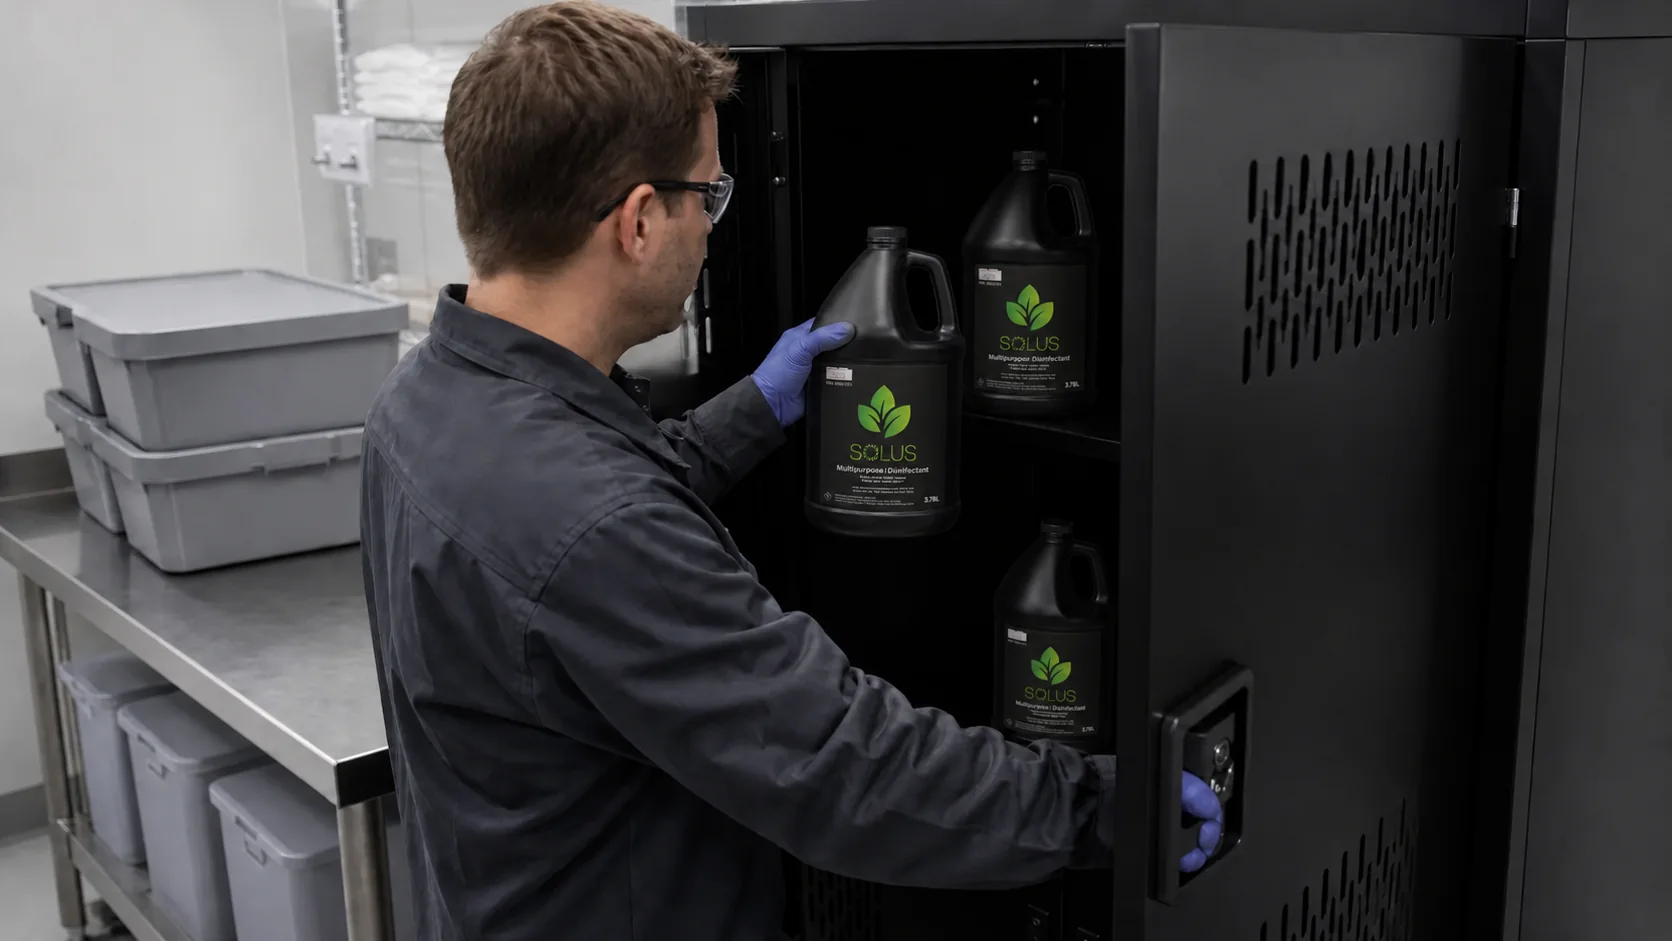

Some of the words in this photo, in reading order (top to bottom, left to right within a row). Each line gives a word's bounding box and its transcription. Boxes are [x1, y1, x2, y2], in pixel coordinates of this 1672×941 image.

[1000, 335, 1060, 351] SOLUS
[849, 443, 917, 461] SOLUS
[1024, 686, 1077, 703] SOLUS
